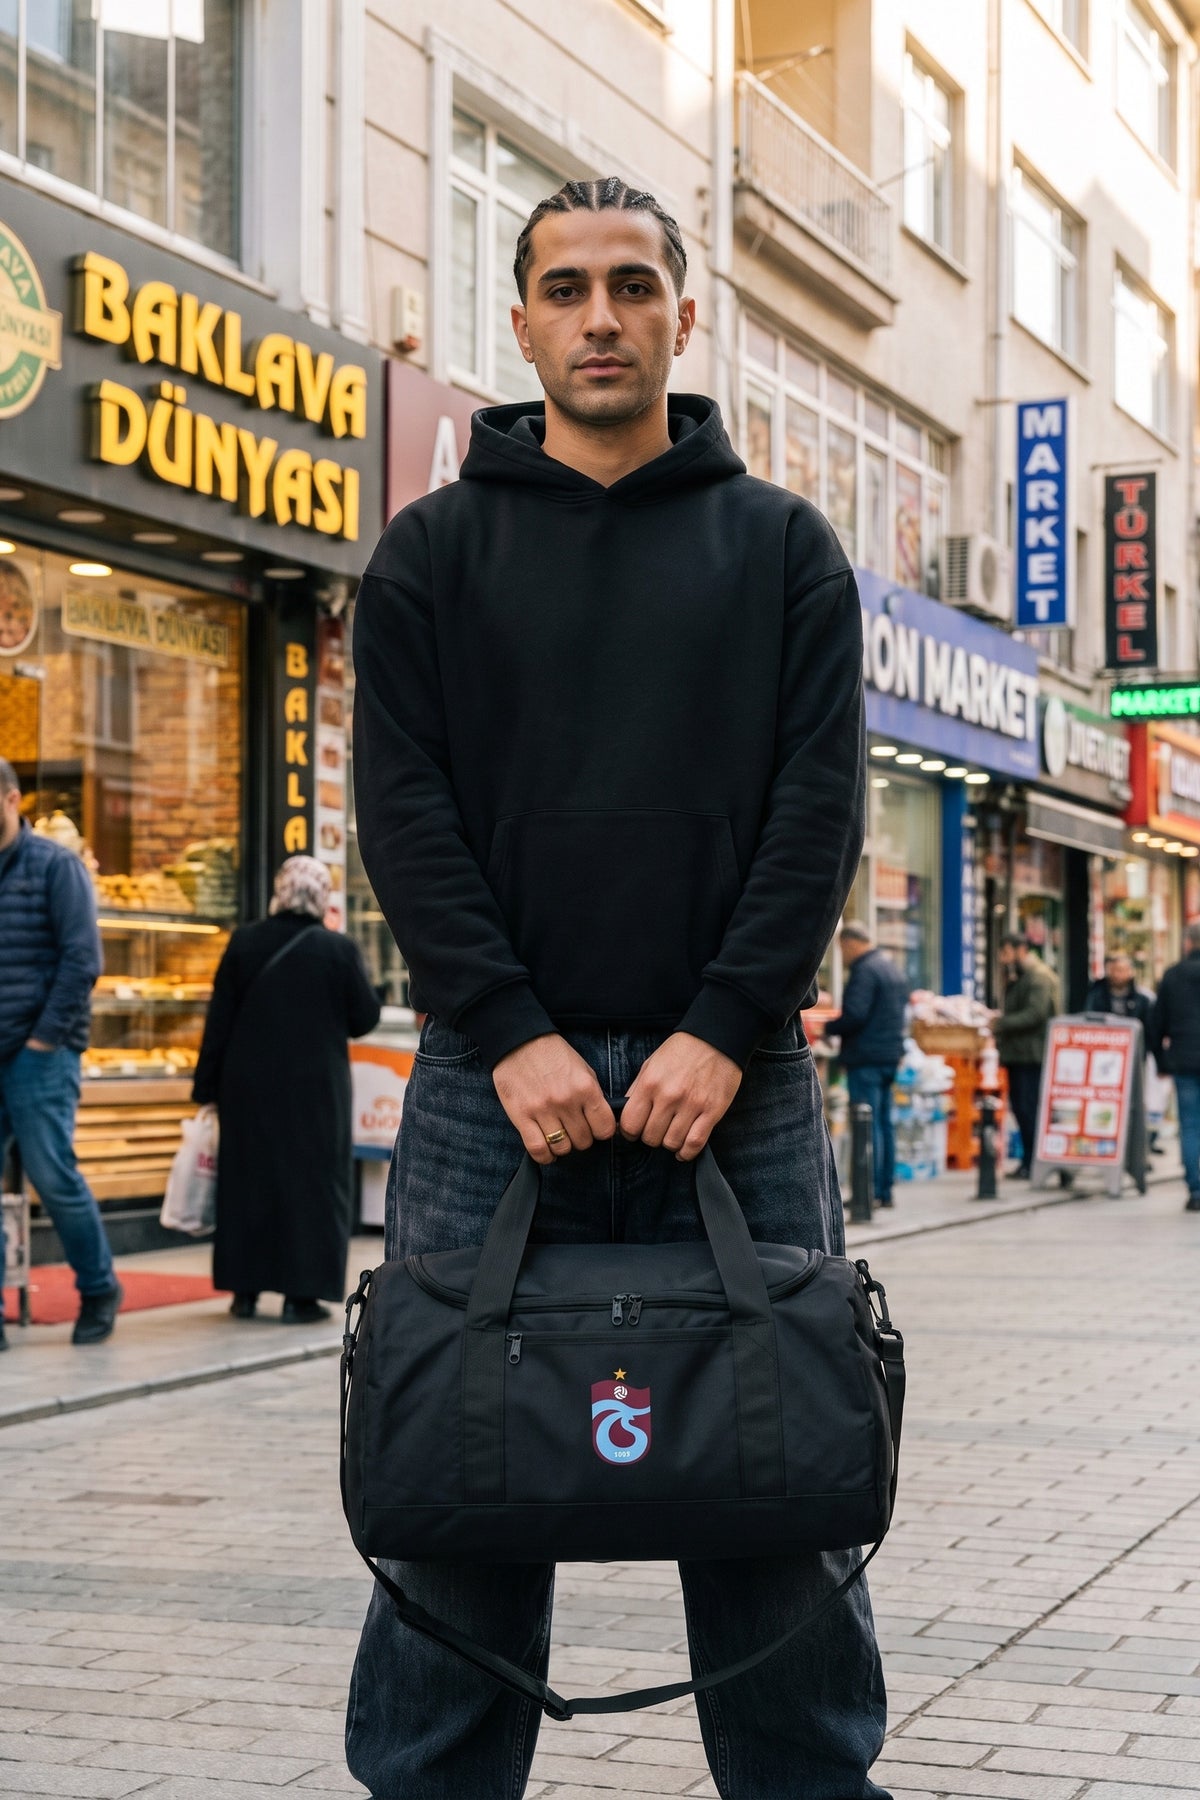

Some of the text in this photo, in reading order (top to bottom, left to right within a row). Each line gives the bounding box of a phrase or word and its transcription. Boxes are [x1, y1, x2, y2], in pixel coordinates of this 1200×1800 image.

[82, 250, 368, 440] BAKLAVA
[98, 378, 360, 543] DÜNYASI
[1022, 404, 1063, 623] MARKET
[1113, 477, 1150, 663] TÜRKEL
[923, 633, 1039, 743] MARKET
[1111, 687, 1200, 717] MARKET
